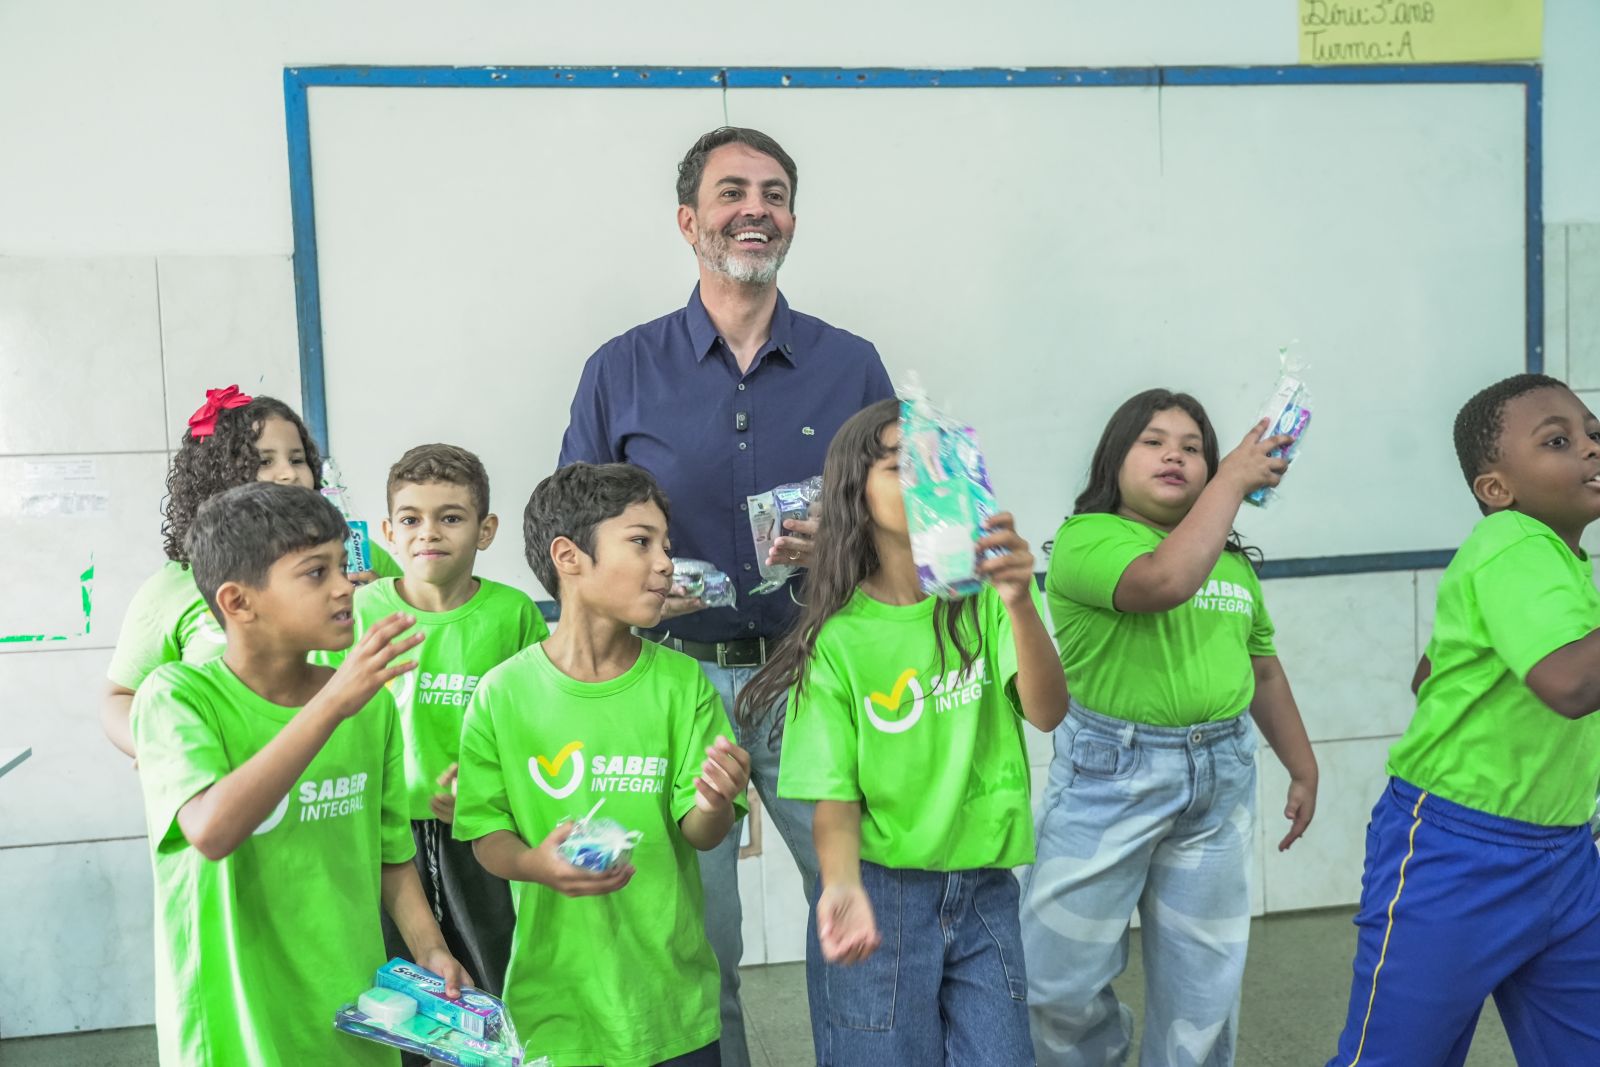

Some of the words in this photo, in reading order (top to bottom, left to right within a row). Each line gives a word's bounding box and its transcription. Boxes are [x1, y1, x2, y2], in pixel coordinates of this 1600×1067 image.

[1193, 596, 1252, 618] INTEGRA
[419, 672, 479, 691] SABE
[418, 691, 471, 706] INTEGR
[591, 755, 668, 777] SABER
[298, 772, 367, 803] SABER
[300, 795, 364, 822] INTEGRAL
